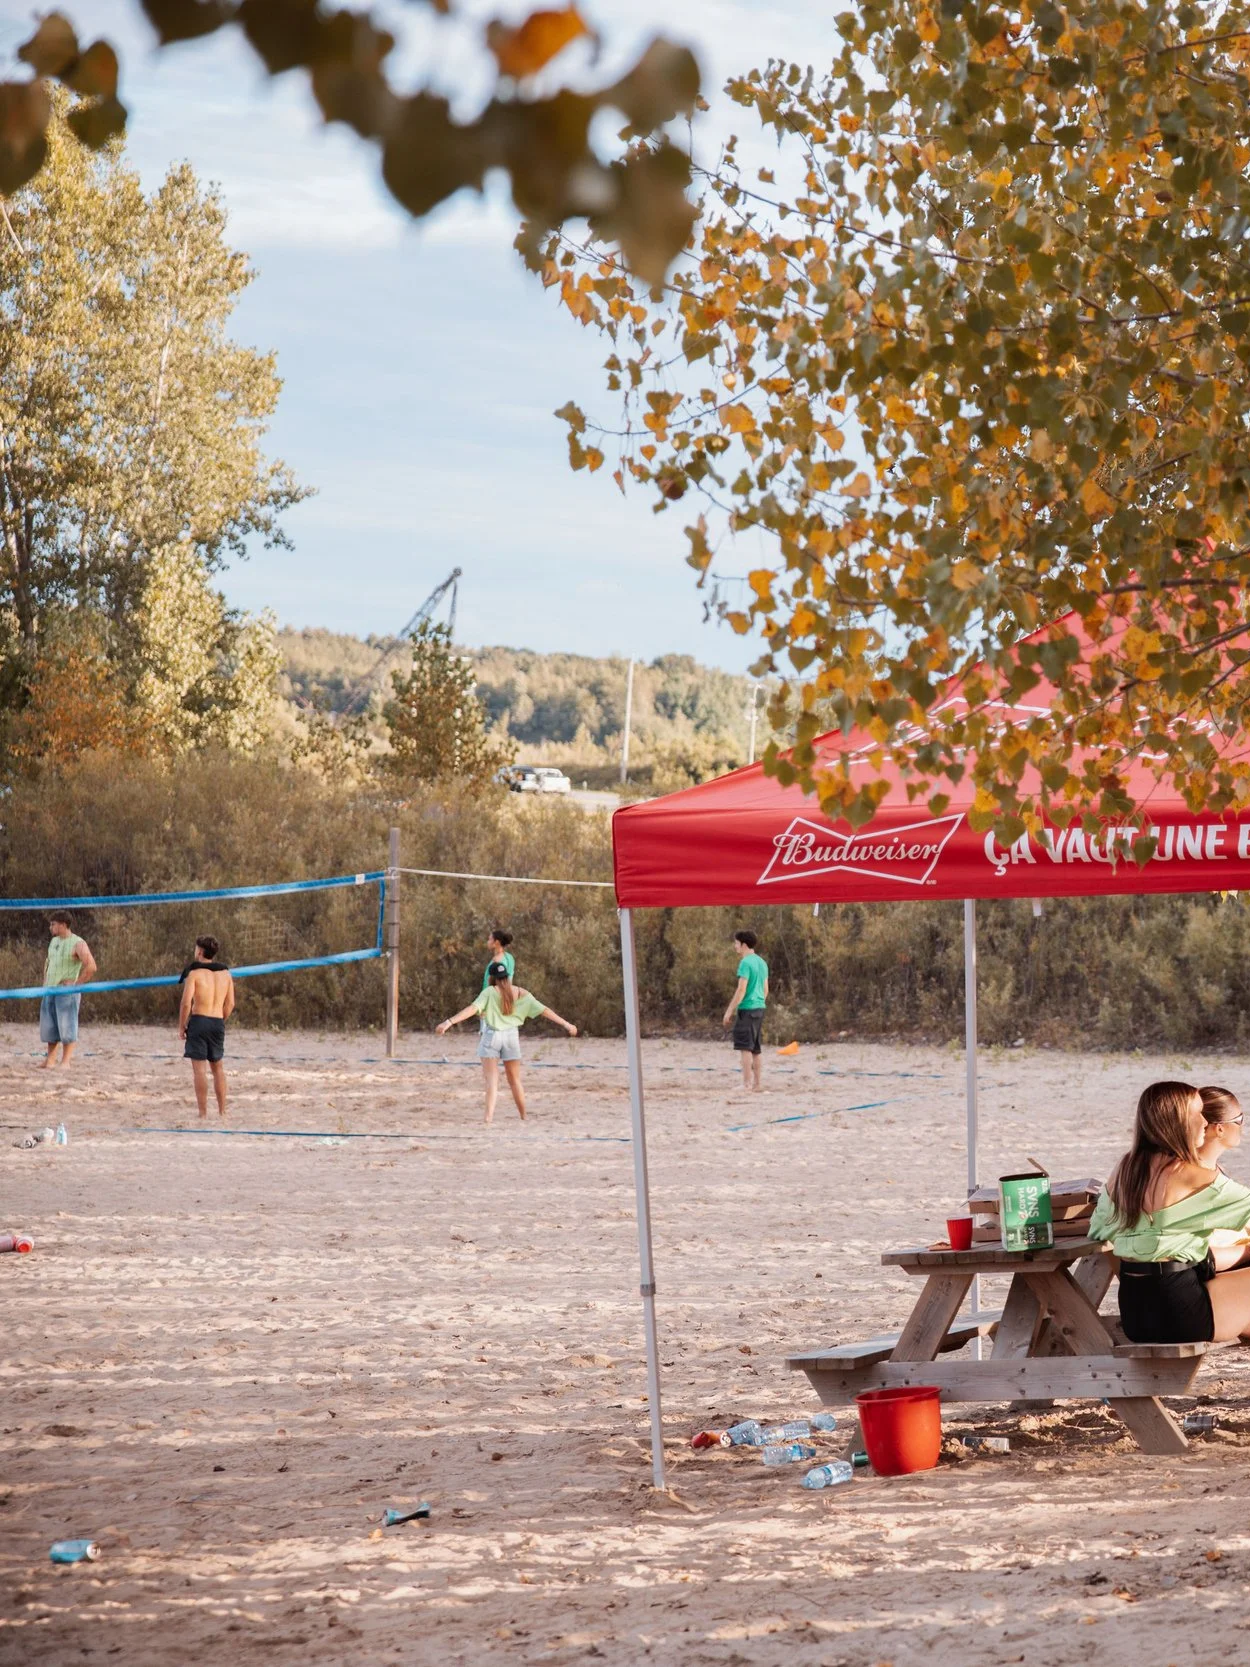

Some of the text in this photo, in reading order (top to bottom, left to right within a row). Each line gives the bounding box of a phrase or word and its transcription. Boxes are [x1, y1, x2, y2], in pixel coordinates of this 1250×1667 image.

[773, 832, 940, 865] Budweiser
[984, 827, 1036, 876] ÇA
[1042, 826, 1139, 863] VAUT
[1149, 825, 1227, 861] UNE
[1027, 1186, 1039, 1218] SVNS
